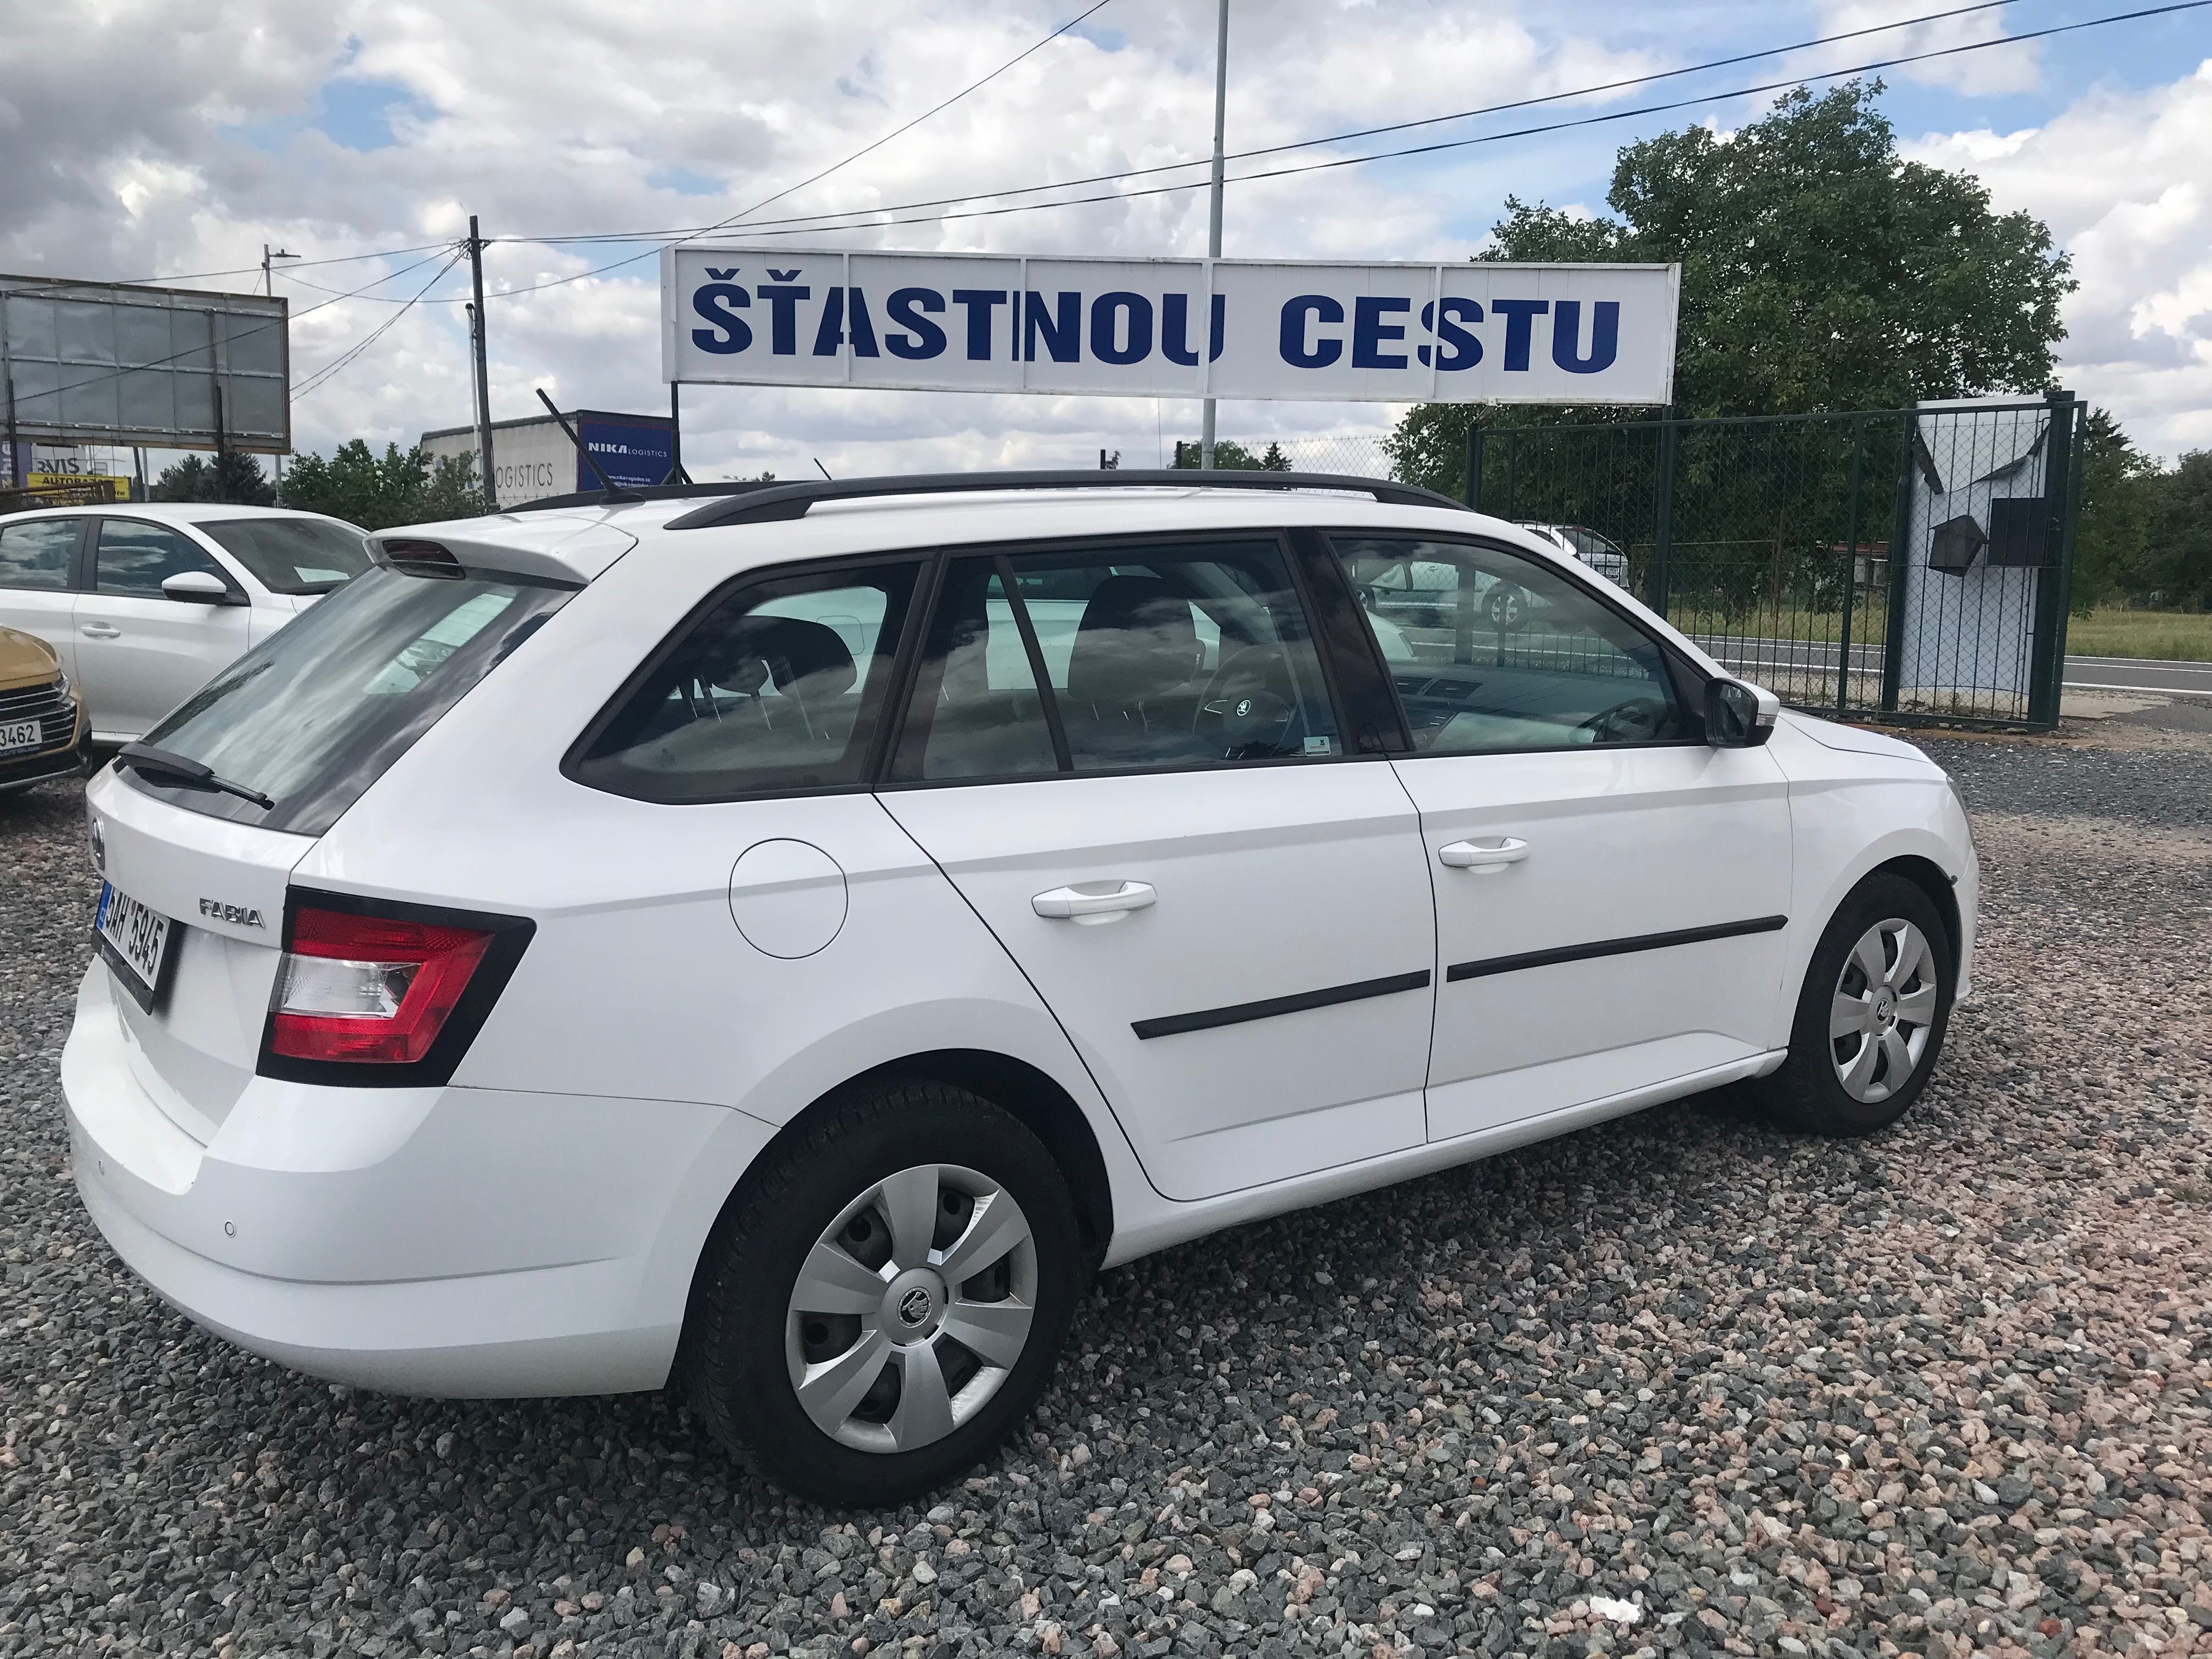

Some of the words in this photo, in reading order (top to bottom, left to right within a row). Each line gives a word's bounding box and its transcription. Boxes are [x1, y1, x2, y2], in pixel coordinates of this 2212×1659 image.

[692, 268, 1225, 366] ŠŤASTNOU
[1279, 295, 1620, 374] CESTU
[588, 442, 628, 454] NIKA
[628, 449, 667, 458] LOGISTICS
[495, 462, 553, 488] OGISTICS
[0, 724, 36, 747] 3462
[199, 897, 266, 929] FABIA
[128, 903, 164, 977] 5945
